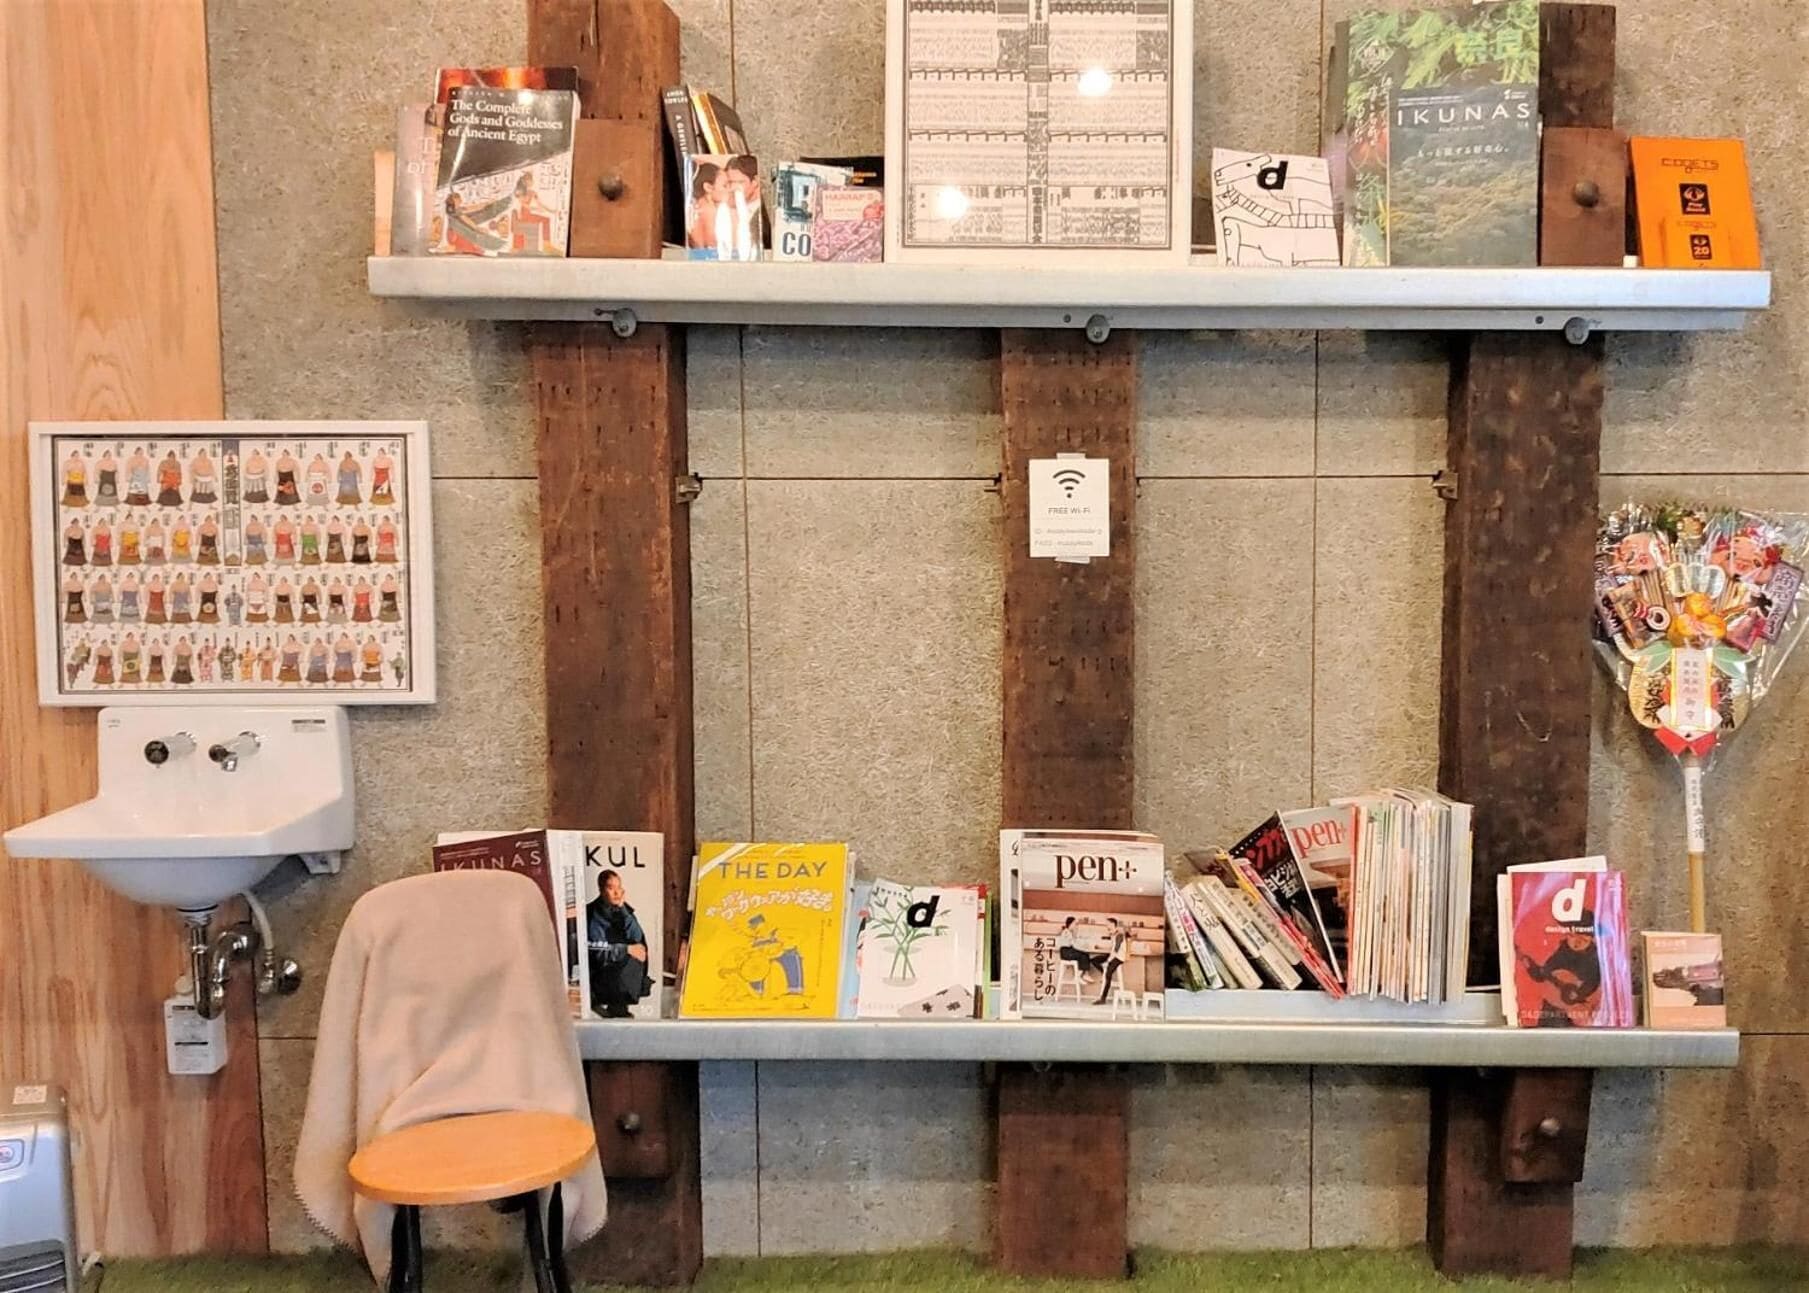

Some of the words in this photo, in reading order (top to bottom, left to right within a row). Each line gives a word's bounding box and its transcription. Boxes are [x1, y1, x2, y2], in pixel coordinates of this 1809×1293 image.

[451, 99, 473, 110] The
[475, 100, 531, 115] Complete
[1397, 102, 1530, 126] IKUNAS
[449, 112, 480, 124] Gods
[481, 115, 503, 126] and
[505, 115, 563, 129] Goddesses
[448, 125, 461, 137] of
[463, 126, 506, 140] Ancient
[508, 130, 542, 145] Egypt
[1257, 161, 1288, 190] d
[1047, 507, 1069, 515] FREE
[585, 845, 646, 868] KUL
[718, 861, 770, 879] THE
[776, 861, 828, 878] DAY
[907, 895, 941, 928] d
[1551, 879, 1588, 922] d
[1045, 937, 1057, 997] コーヒーの
